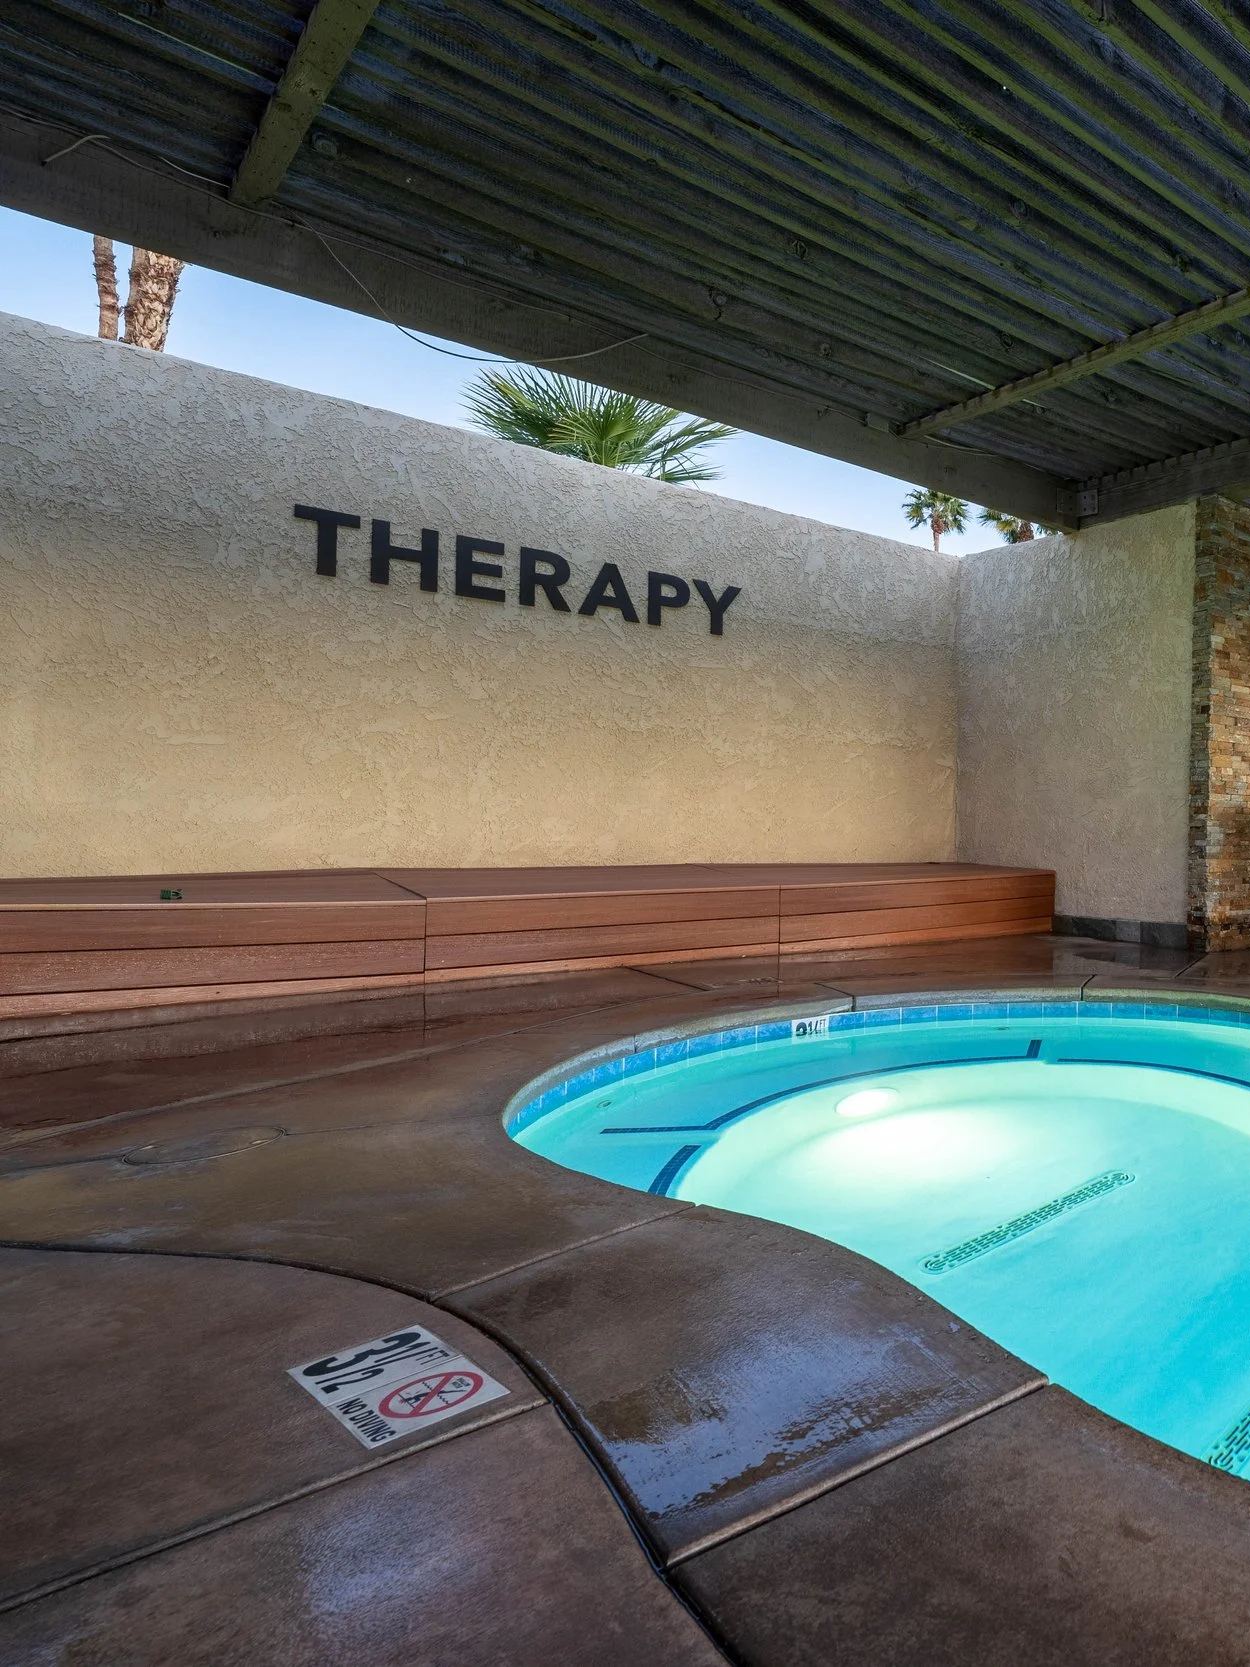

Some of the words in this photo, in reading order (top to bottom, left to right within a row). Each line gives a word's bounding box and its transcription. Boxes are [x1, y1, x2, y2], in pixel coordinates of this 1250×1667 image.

[294, 504, 742, 636] THERAPY
[415, 1350, 450, 1366] FT
[336, 1397, 368, 1415] NO
[349, 1409, 397, 1442] DIVING
